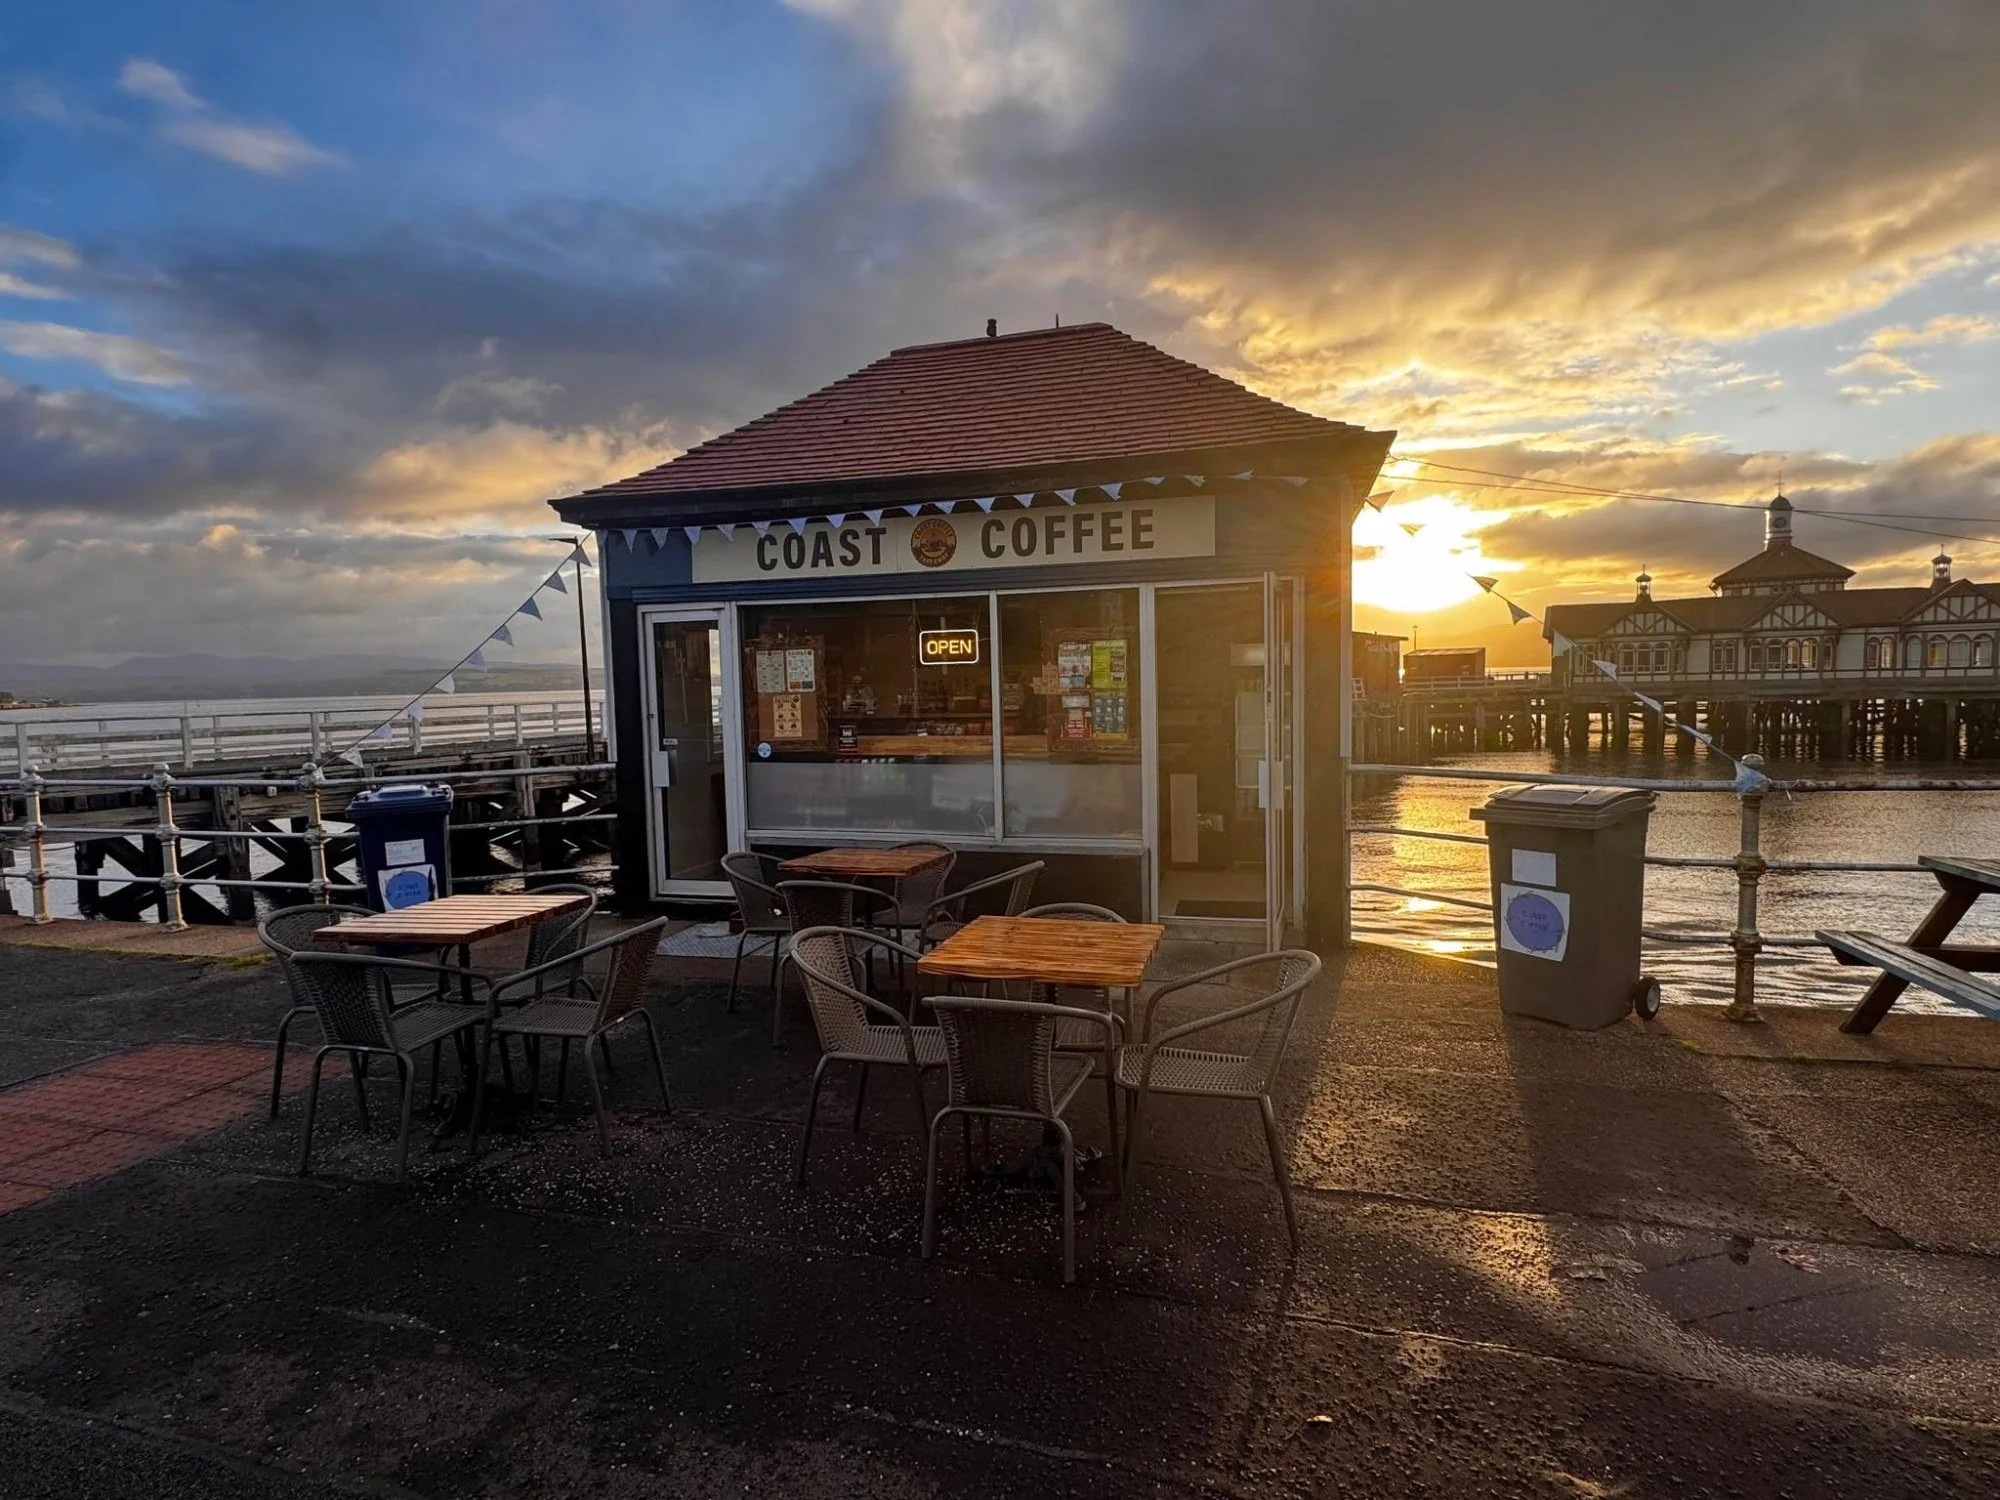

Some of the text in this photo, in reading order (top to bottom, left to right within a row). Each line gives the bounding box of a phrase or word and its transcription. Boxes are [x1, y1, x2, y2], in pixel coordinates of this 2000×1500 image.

[931, 520, 953, 538] COFFEE
[757, 509, 1154, 571] COAST COFFEE
[927, 639, 972, 655] OPEN
